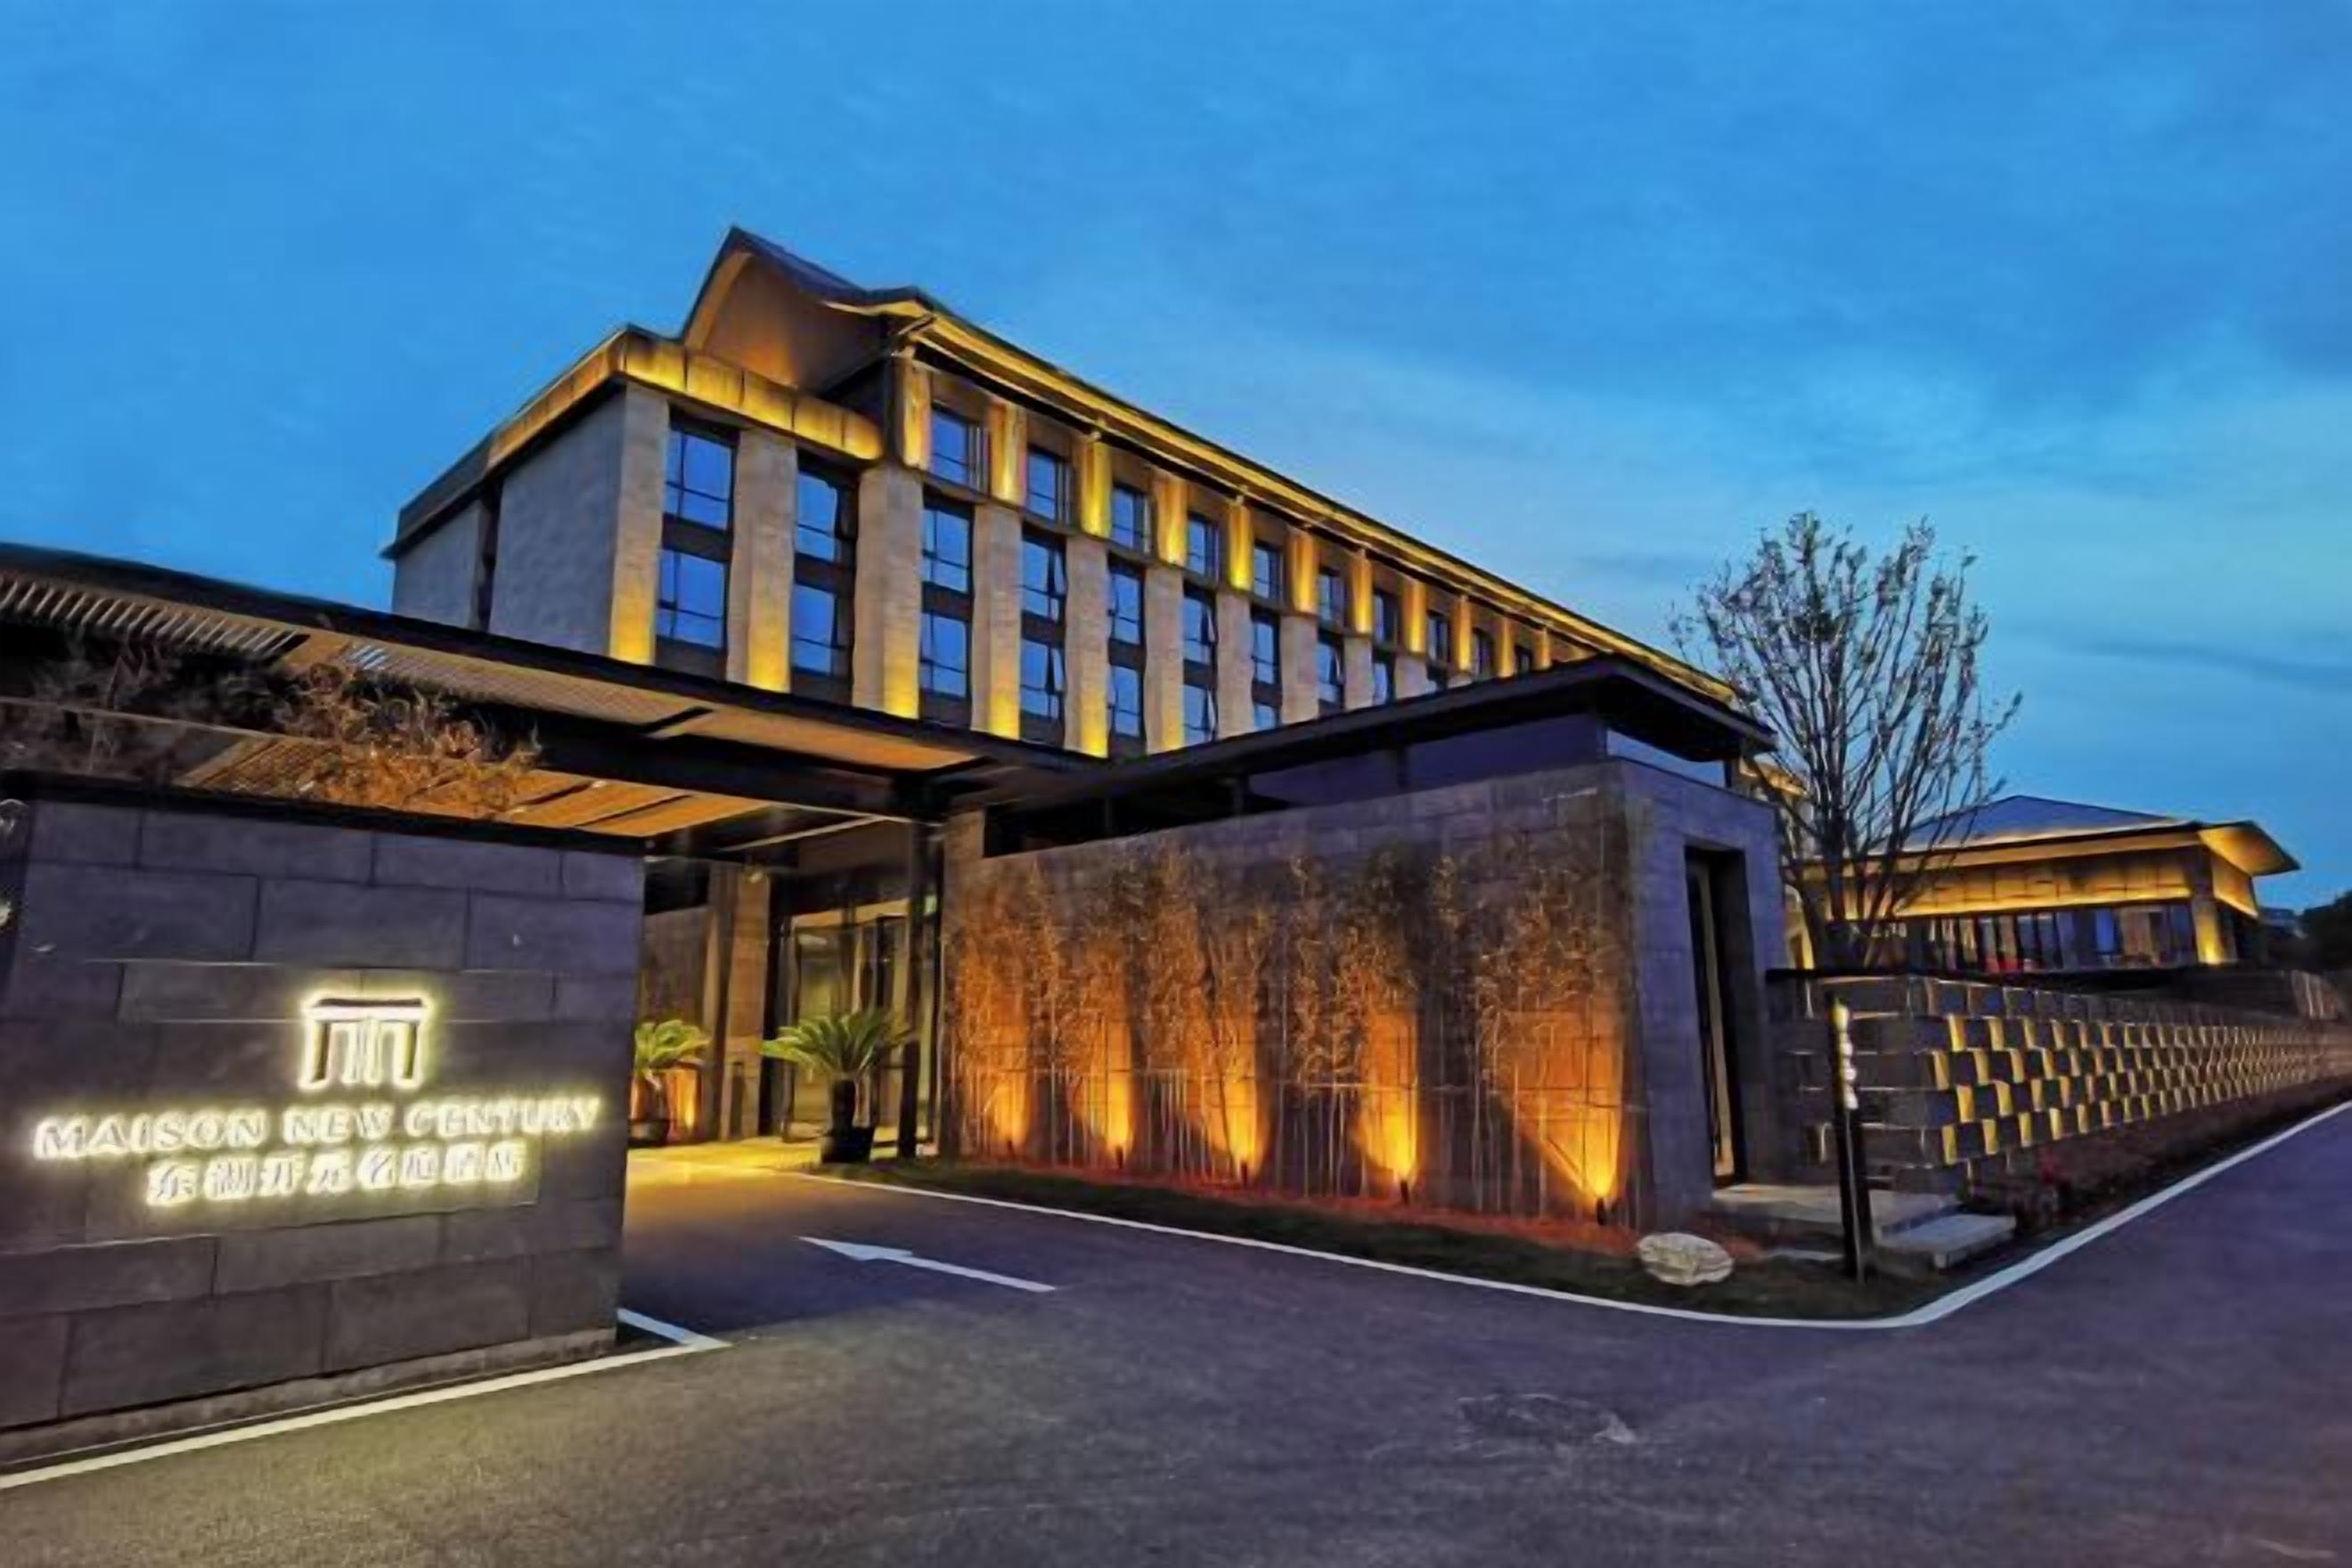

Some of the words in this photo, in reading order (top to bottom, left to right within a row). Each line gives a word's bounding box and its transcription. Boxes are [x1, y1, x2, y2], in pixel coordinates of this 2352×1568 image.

[36, 1111, 265, 1159] MAISON
[283, 1107, 393, 1143] NEW
[406, 1098, 600, 1137] CENTURY
